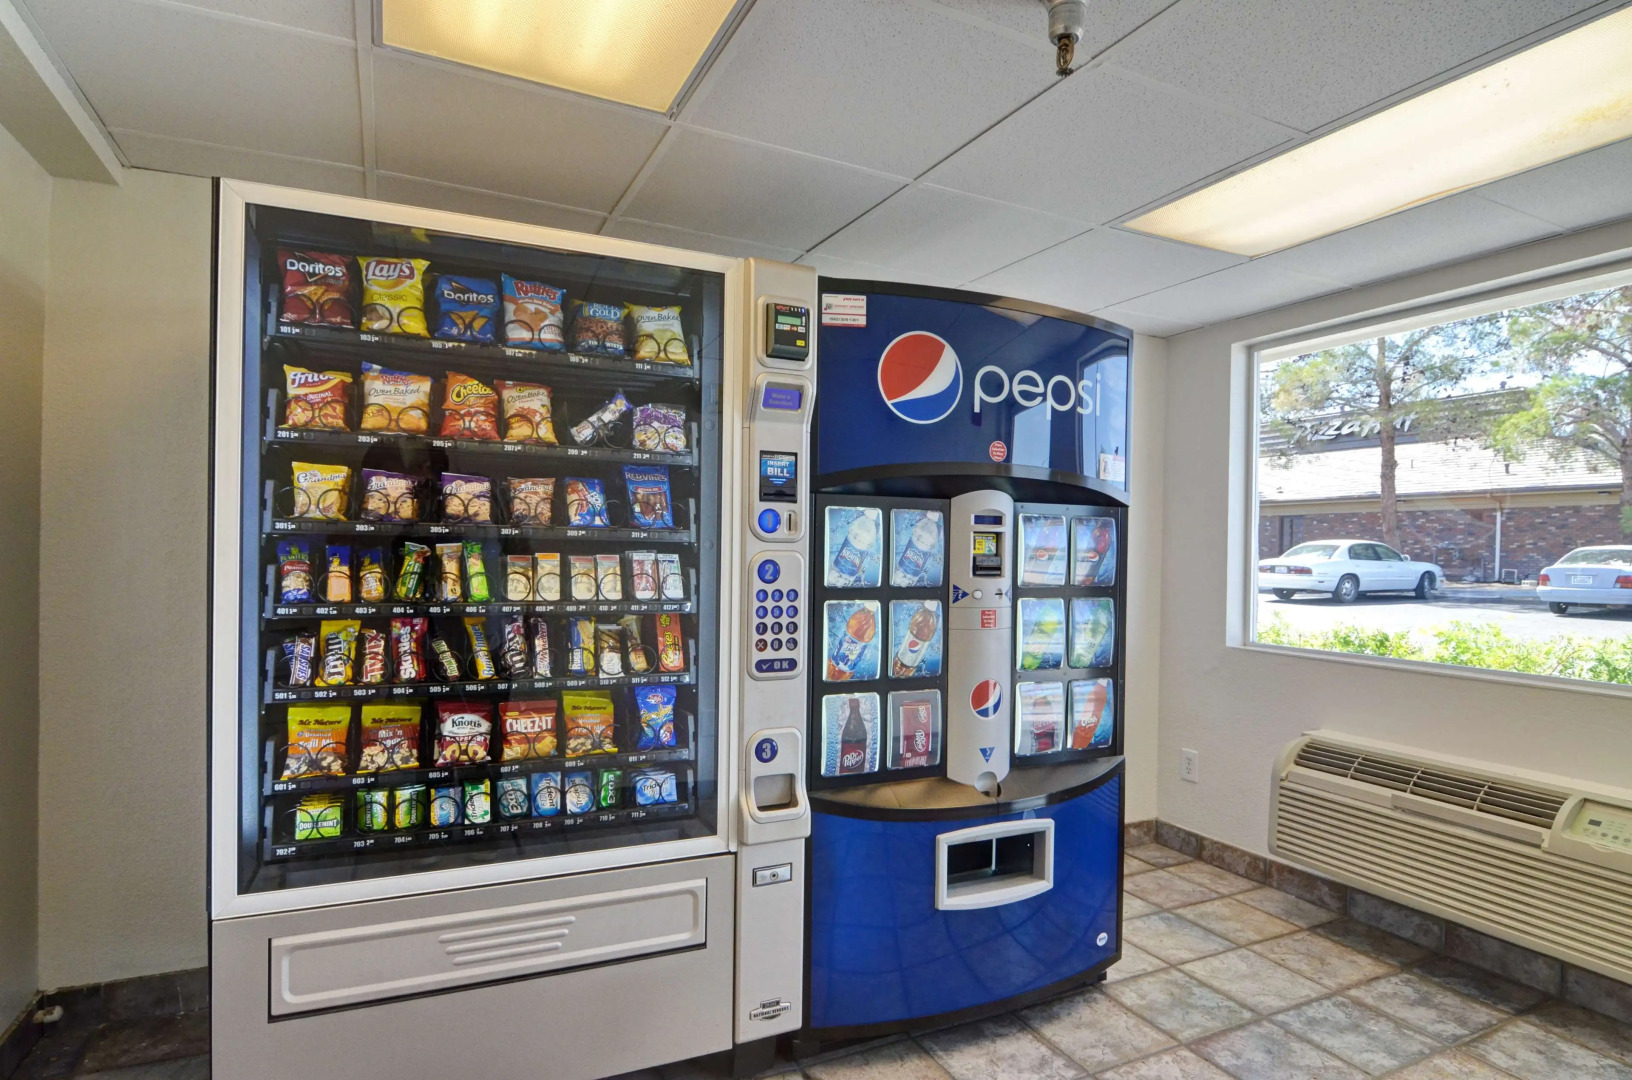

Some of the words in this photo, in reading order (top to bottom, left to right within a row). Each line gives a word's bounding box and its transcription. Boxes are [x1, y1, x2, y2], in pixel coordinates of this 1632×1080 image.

[286, 258, 343, 277] Doritos
[366, 260, 413, 280] Lay's
[371, 292, 408, 302] Classic
[443, 288, 494, 303] Doritos
[589, 308, 620, 318] GOLD
[279, 325, 291, 333] 101
[360, 334, 371, 342] 103
[368, 387, 393, 396] Oven
[393, 385, 421, 394] Baked
[450, 384, 496, 405] Cheeto
[974, 365, 1101, 421] pepsi
[277, 430, 289, 438] 201
[357, 435, 370, 443] 203
[767, 466, 790, 477] BILL
[625, 472, 644, 481] RED
[643, 472, 668, 481] VINES
[766, 513, 772, 528] 1
[275, 522, 288, 530] 301
[764, 563, 774, 580] 2
[276, 607, 289, 615] 401
[315, 607, 329, 615] 402
[774, 608, 779, 616] 5
[759, 624, 764, 632] 7
[774, 624, 779, 632] 8
[788, 624, 794, 632] 9
[773, 641, 779, 649] 0
[773, 660, 790, 670] OK
[451, 716, 482, 729] Knott's
[506, 716, 553, 732] CHEEZ-IT
[378, 730, 394, 739] Mix
[762, 743, 771, 759] 3
[274, 783, 287, 791] 601
[544, 778, 556, 807] Trident
[276, 848, 288, 856] 702
